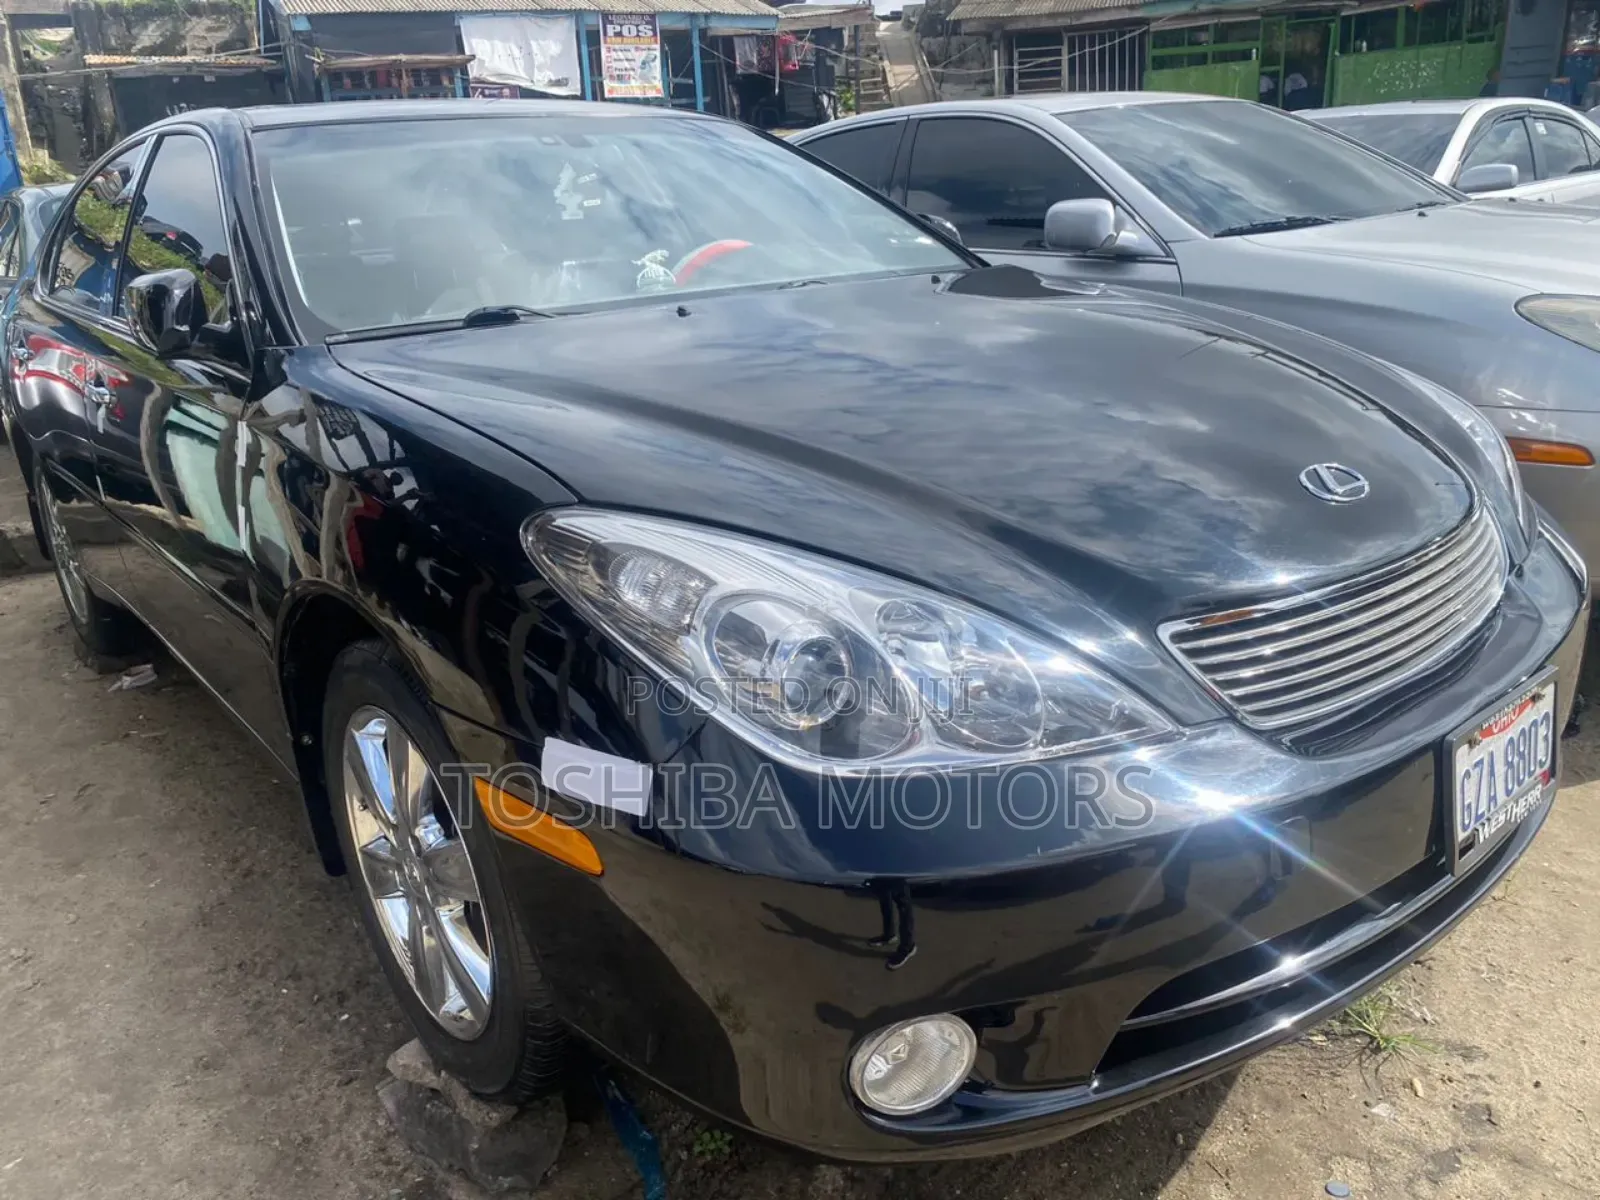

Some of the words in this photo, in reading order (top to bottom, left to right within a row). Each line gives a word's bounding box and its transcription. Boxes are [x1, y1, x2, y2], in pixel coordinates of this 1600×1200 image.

[606, 24, 653, 36] POS
[1460, 750, 1498, 833] GZA
[1504, 710, 1551, 798] 8803
